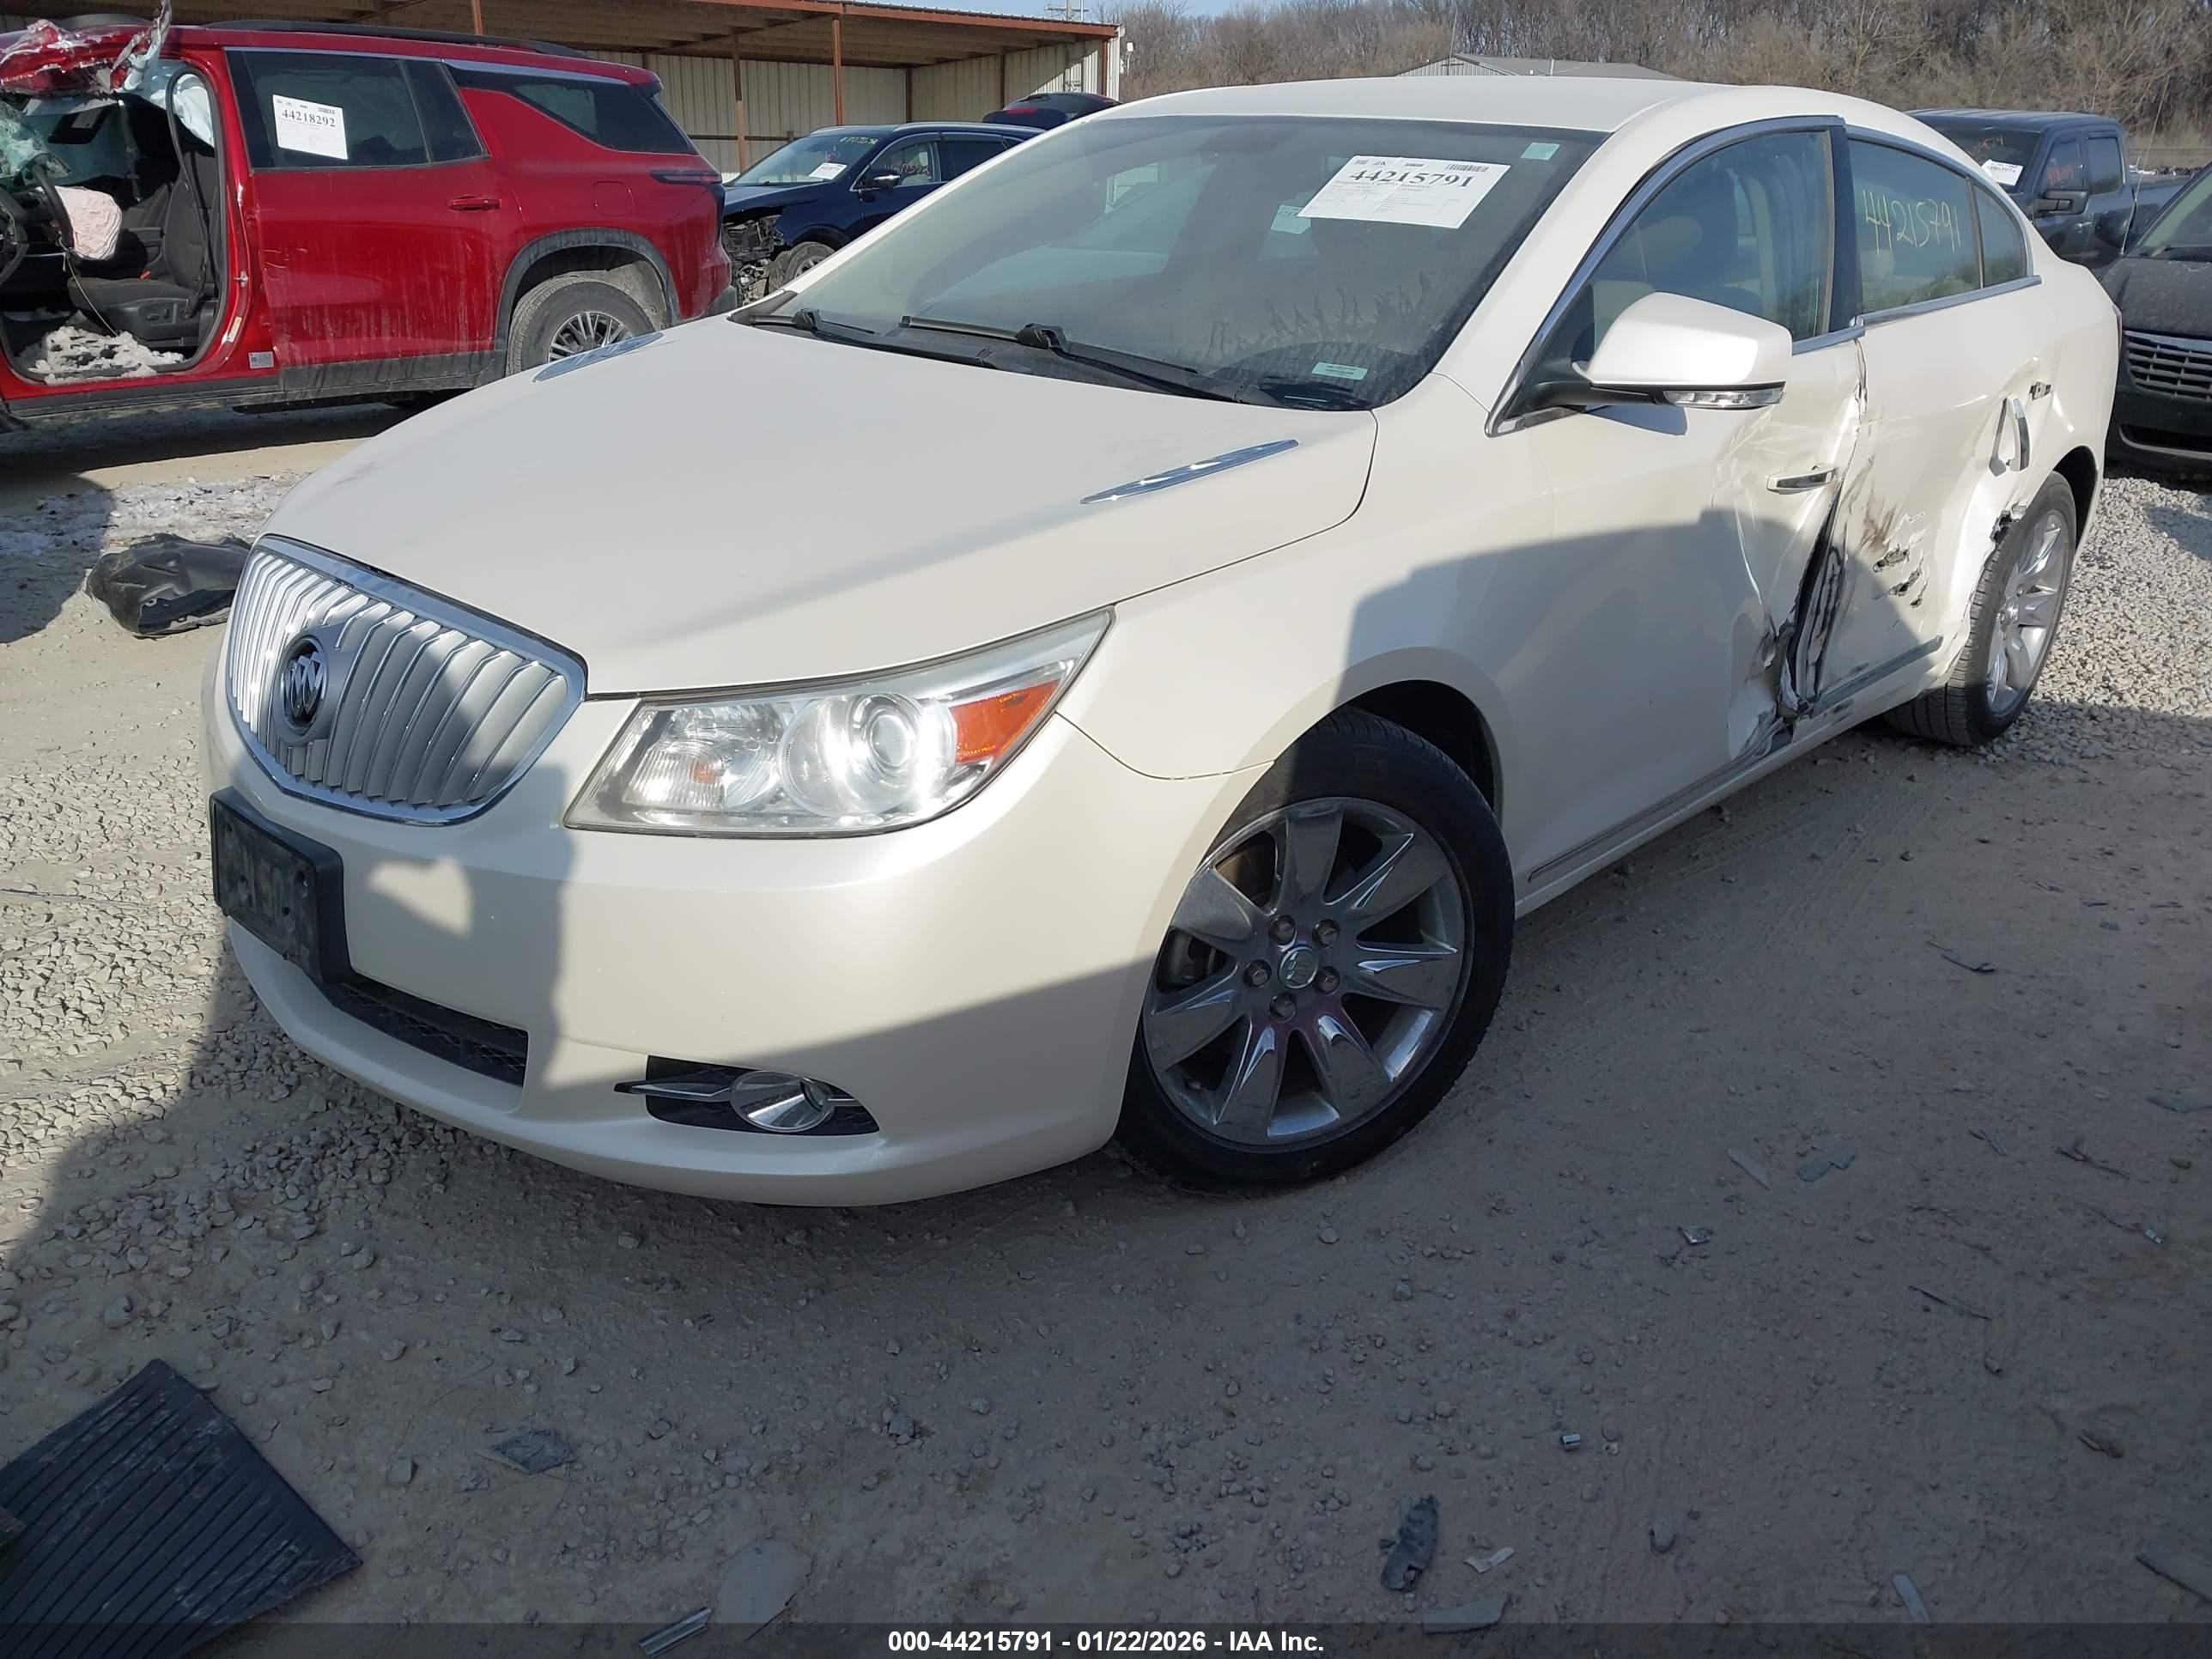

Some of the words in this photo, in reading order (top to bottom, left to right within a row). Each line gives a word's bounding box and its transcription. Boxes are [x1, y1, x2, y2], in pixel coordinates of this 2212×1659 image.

[282, 109, 336, 127] 44218292
[1350, 170, 1474, 187] 44215791
[1863, 189, 1961, 255] 44215791
